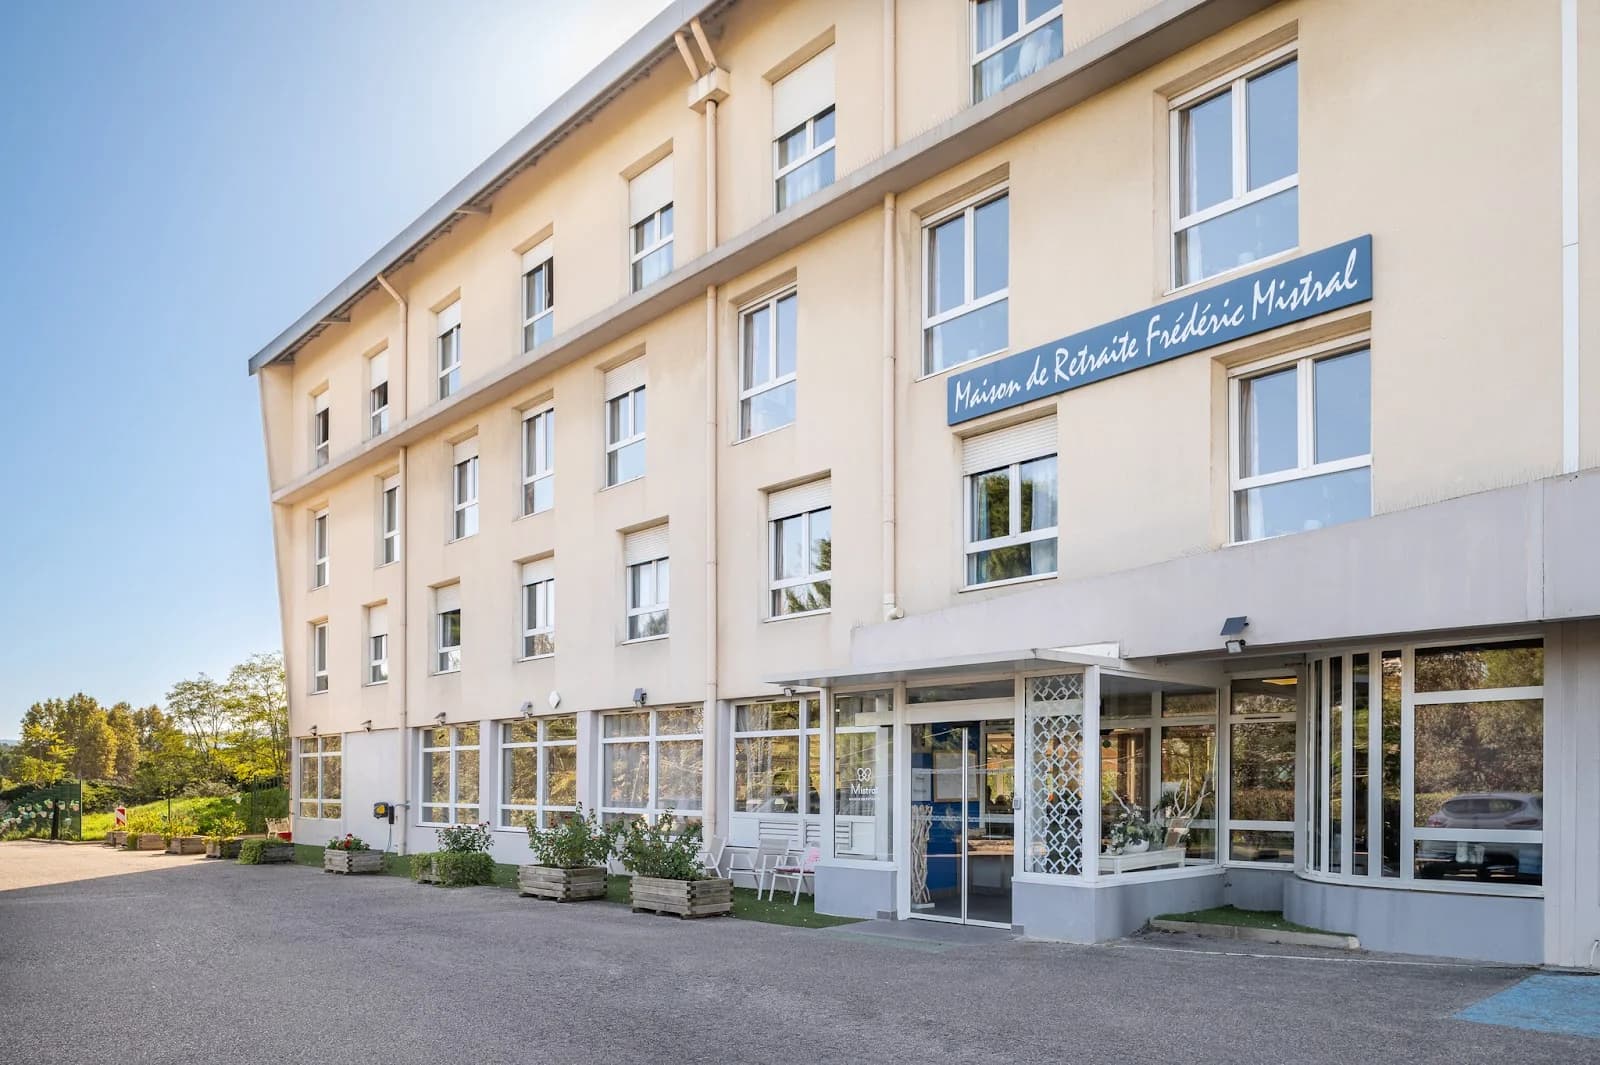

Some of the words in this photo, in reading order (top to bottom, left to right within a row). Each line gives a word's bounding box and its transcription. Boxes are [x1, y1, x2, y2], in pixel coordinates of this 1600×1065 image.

[954, 380, 1021, 413] Maison
[1026, 355, 1049, 391] de
[1054, 331, 1139, 383] Retraite
[1146, 298, 1245, 357] Frédéric
[1252, 247, 1359, 321] Mistral
